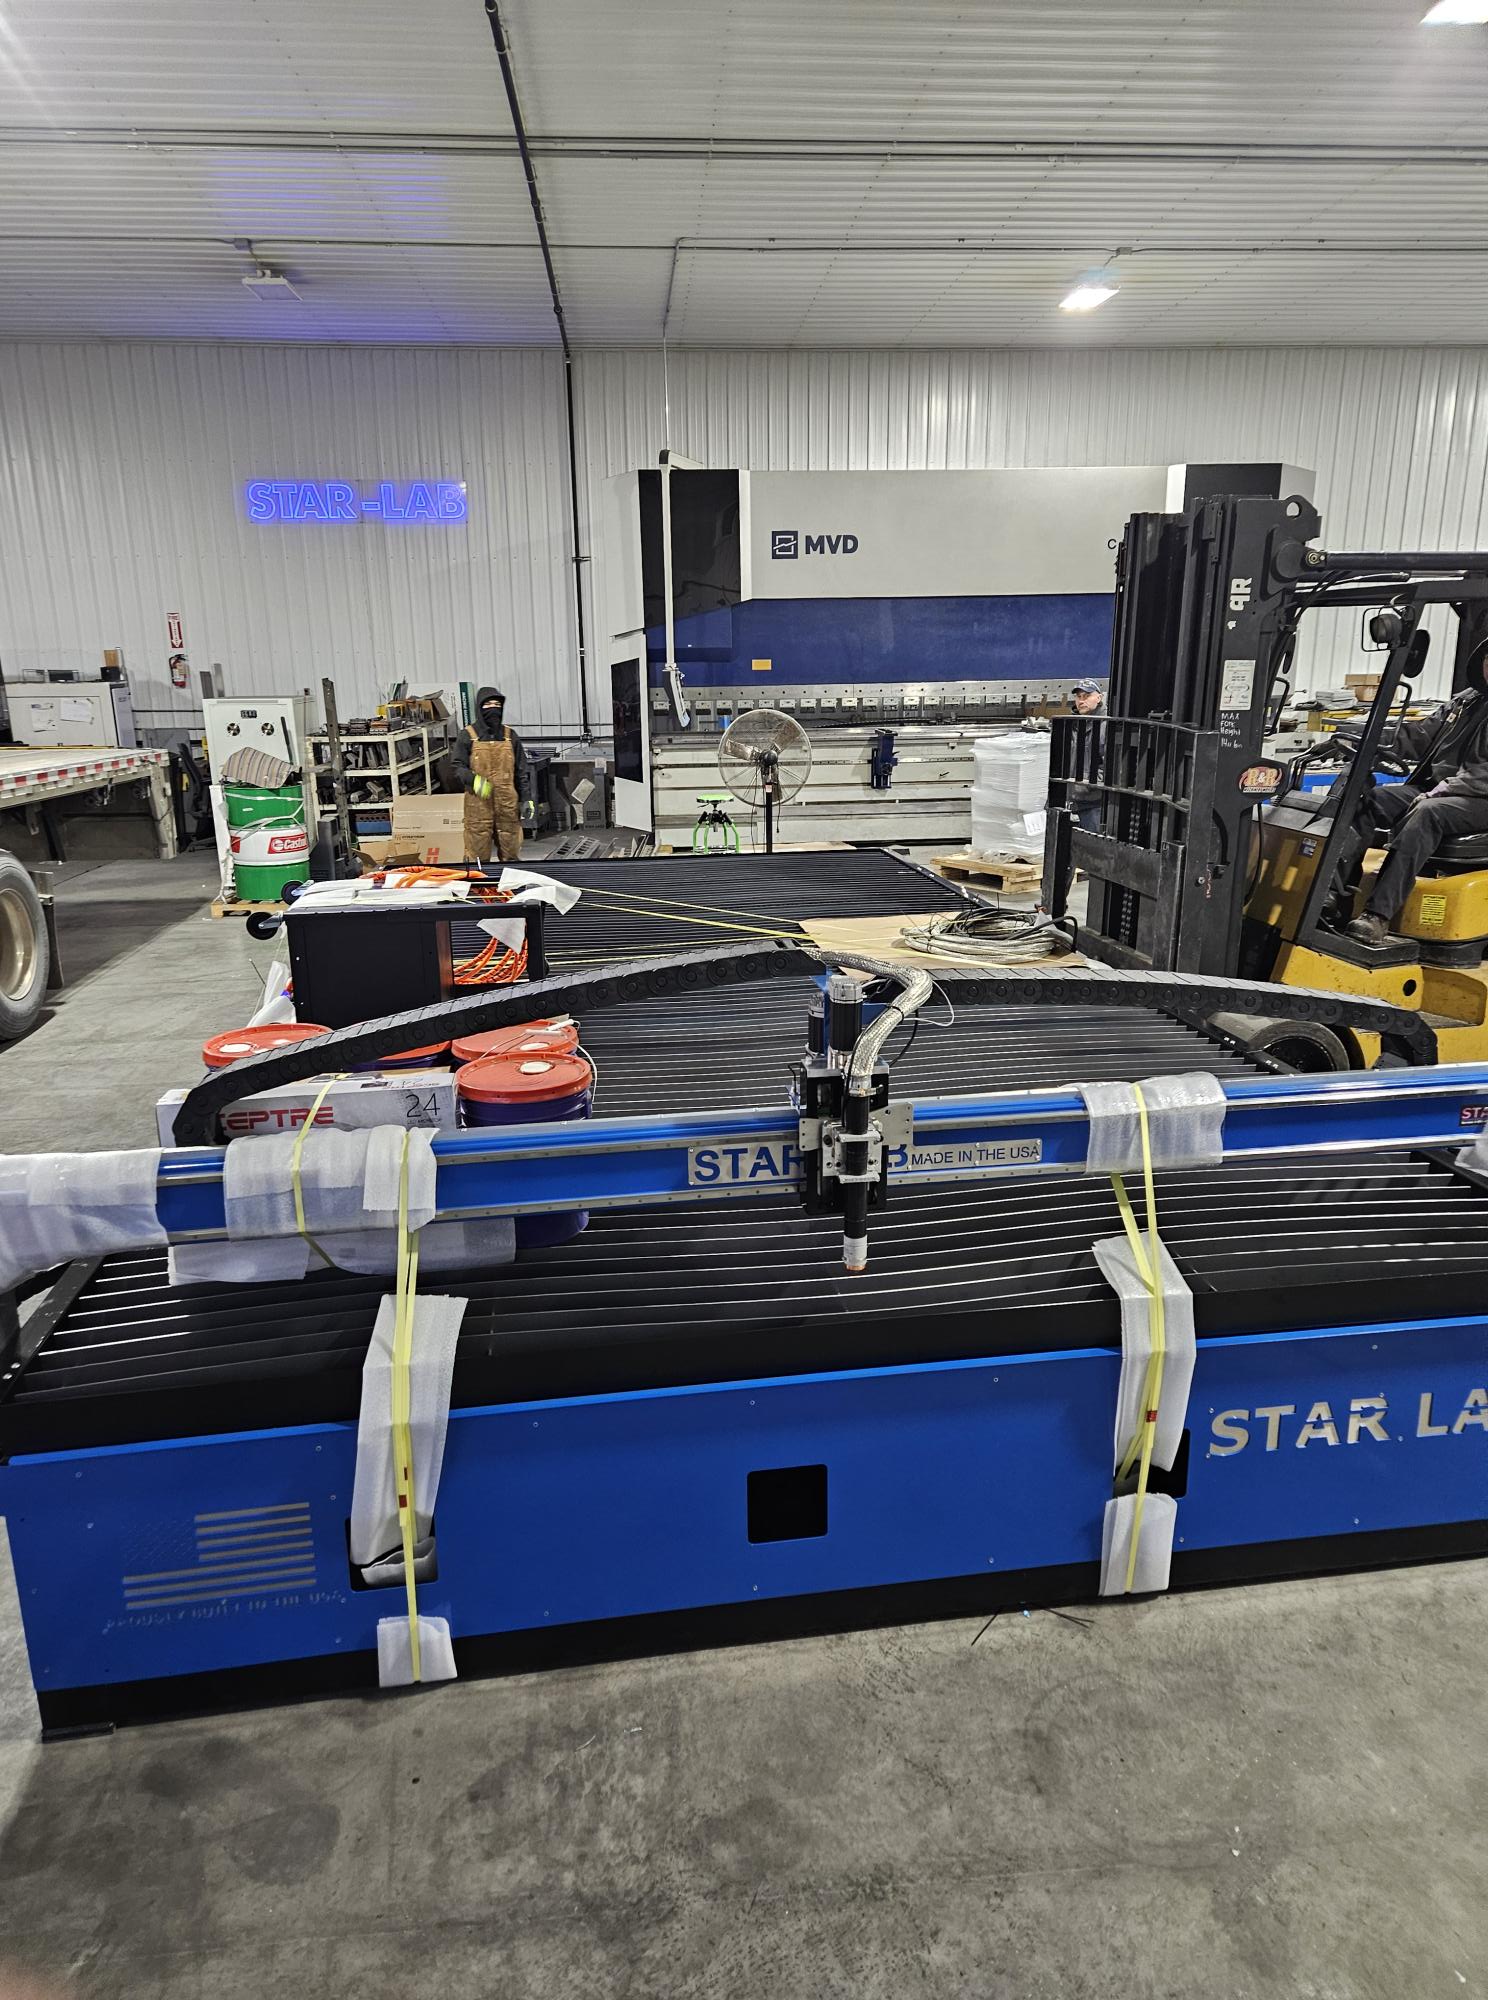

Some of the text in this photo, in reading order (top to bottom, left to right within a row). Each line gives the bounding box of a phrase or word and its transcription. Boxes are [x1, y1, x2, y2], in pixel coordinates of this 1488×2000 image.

[805, 535, 859, 554] MVD
[218, 1105, 335, 1131] EPTRE
[405, 1092, 441, 1118] 24
[911, 1151, 953, 1167] MADE
[957, 1150, 973, 1163] IN
[977, 1147, 1006, 1162] THE
[1009, 1145, 1040, 1160] USA
[1209, 1397, 1391, 1457] STAR
